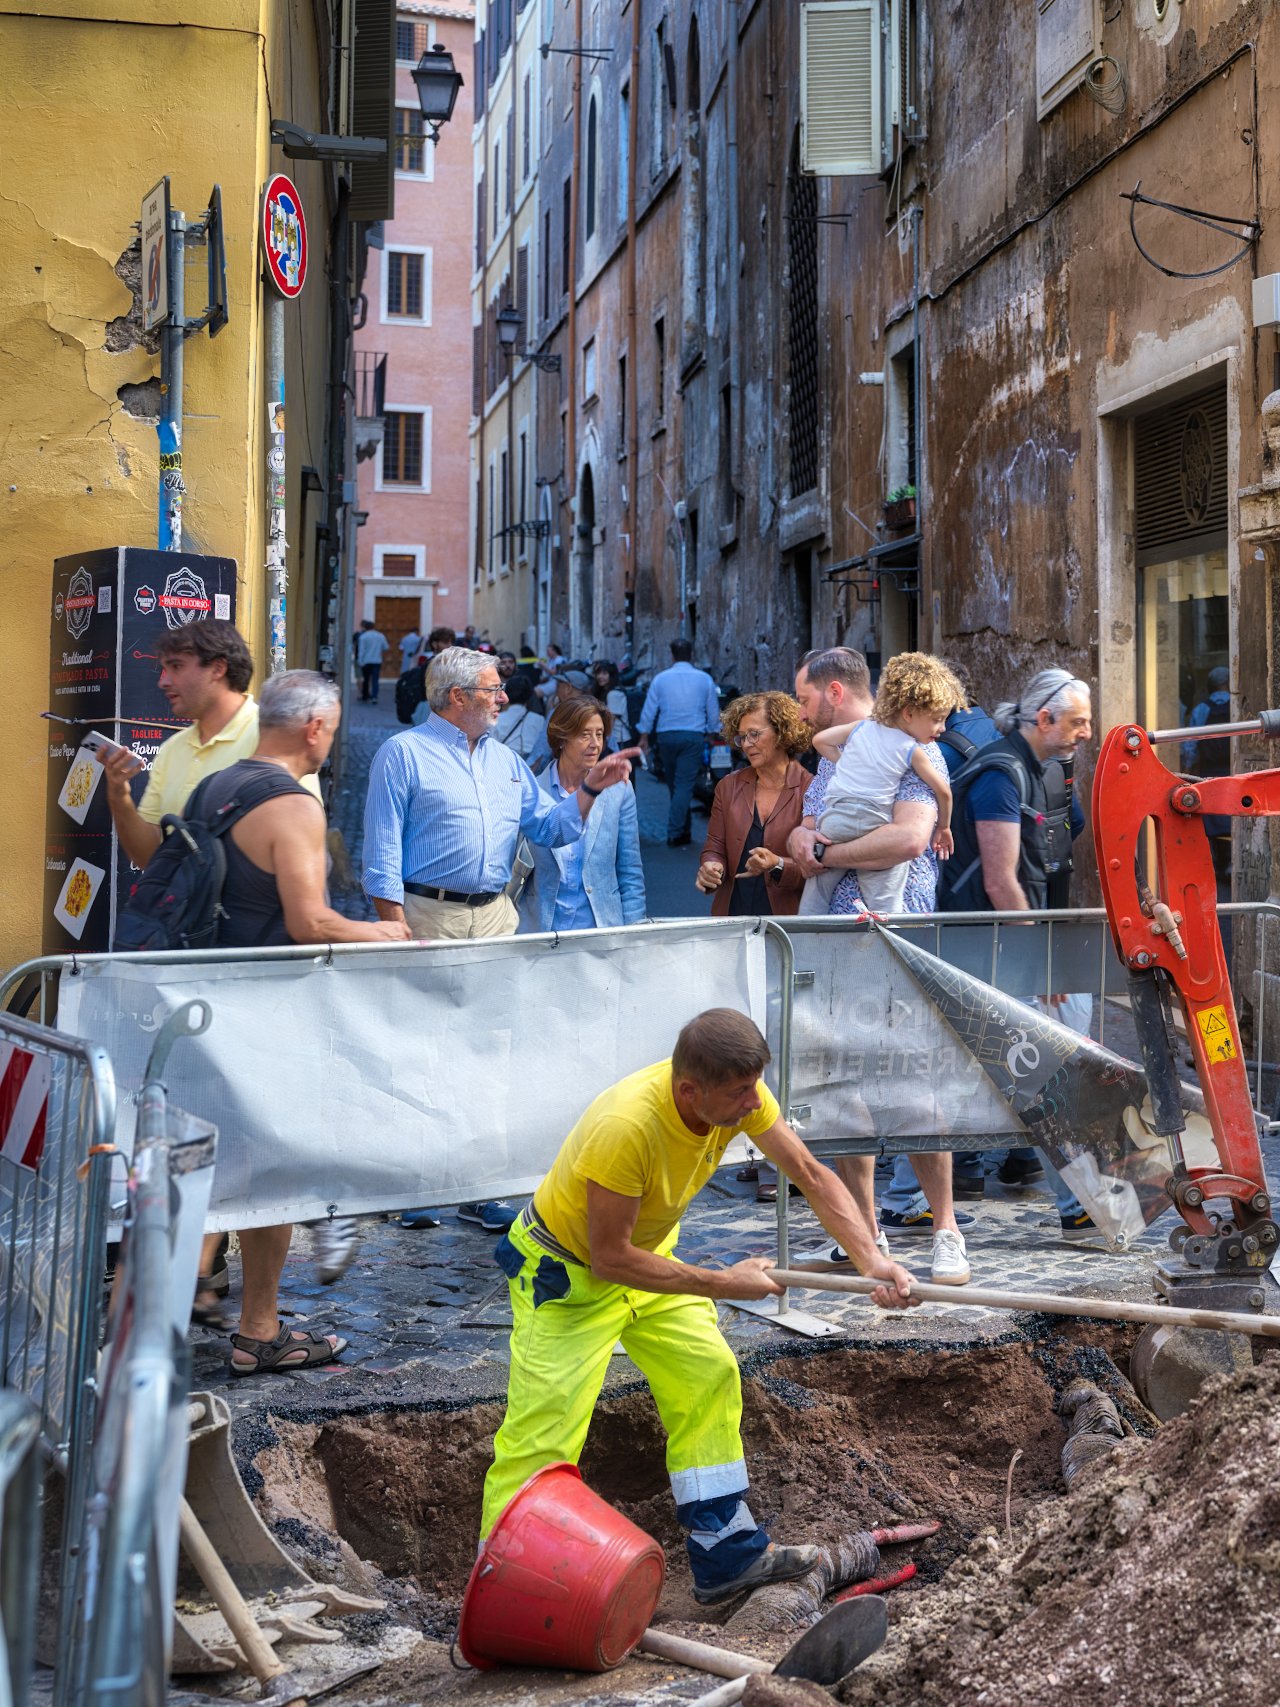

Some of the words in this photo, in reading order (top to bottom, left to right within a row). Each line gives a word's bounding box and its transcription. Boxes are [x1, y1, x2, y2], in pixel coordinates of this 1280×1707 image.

[163, 597, 181, 606] PASTA
[181, 599, 188, 607] IN
[188, 600, 208, 608] CORSO
[85, 667, 109, 681] PASTA
[131, 729, 163, 739] TAGLIERE
[131, 741, 160, 755] Form
